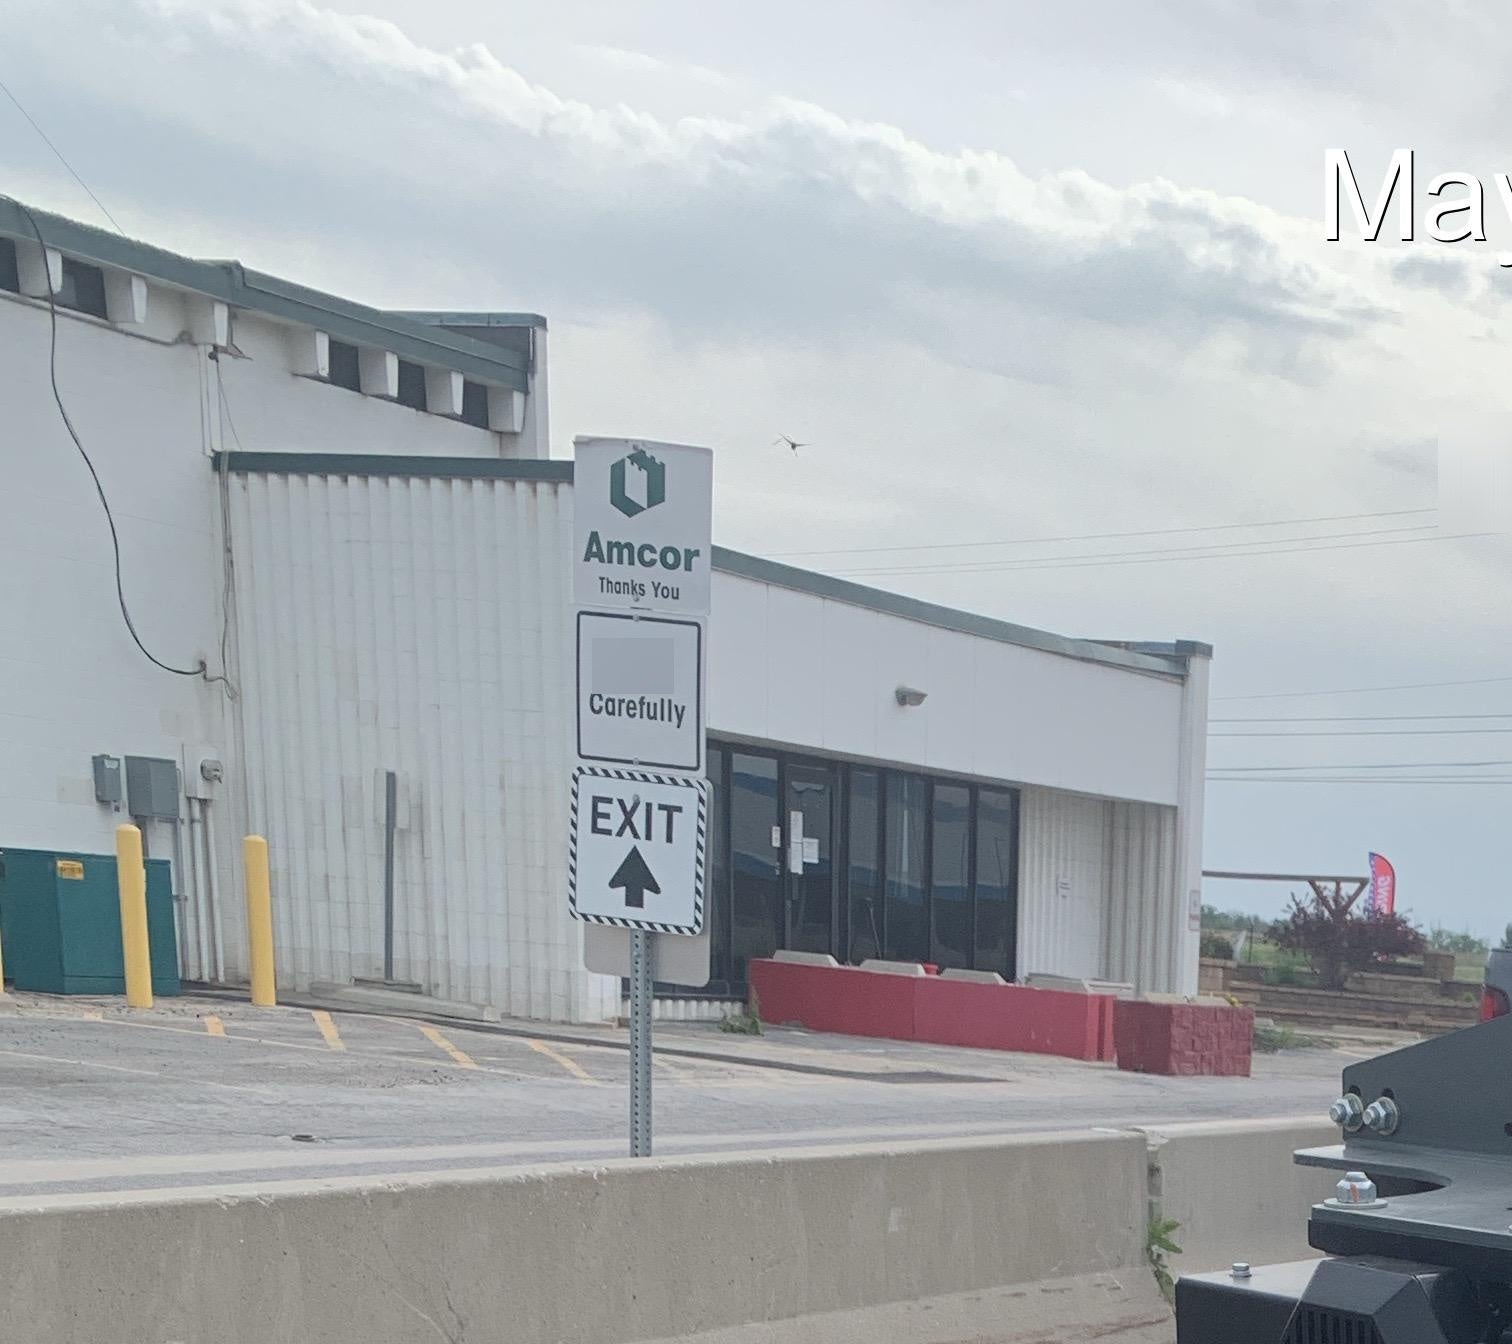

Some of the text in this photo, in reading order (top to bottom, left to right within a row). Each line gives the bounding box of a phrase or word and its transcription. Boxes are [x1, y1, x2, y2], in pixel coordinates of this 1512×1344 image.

[583, 531, 700, 572] Amcor
[599, 577, 680, 600] Thanks You
[589, 693, 686, 729] Carefully
[591, 795, 683, 844] EXIT
